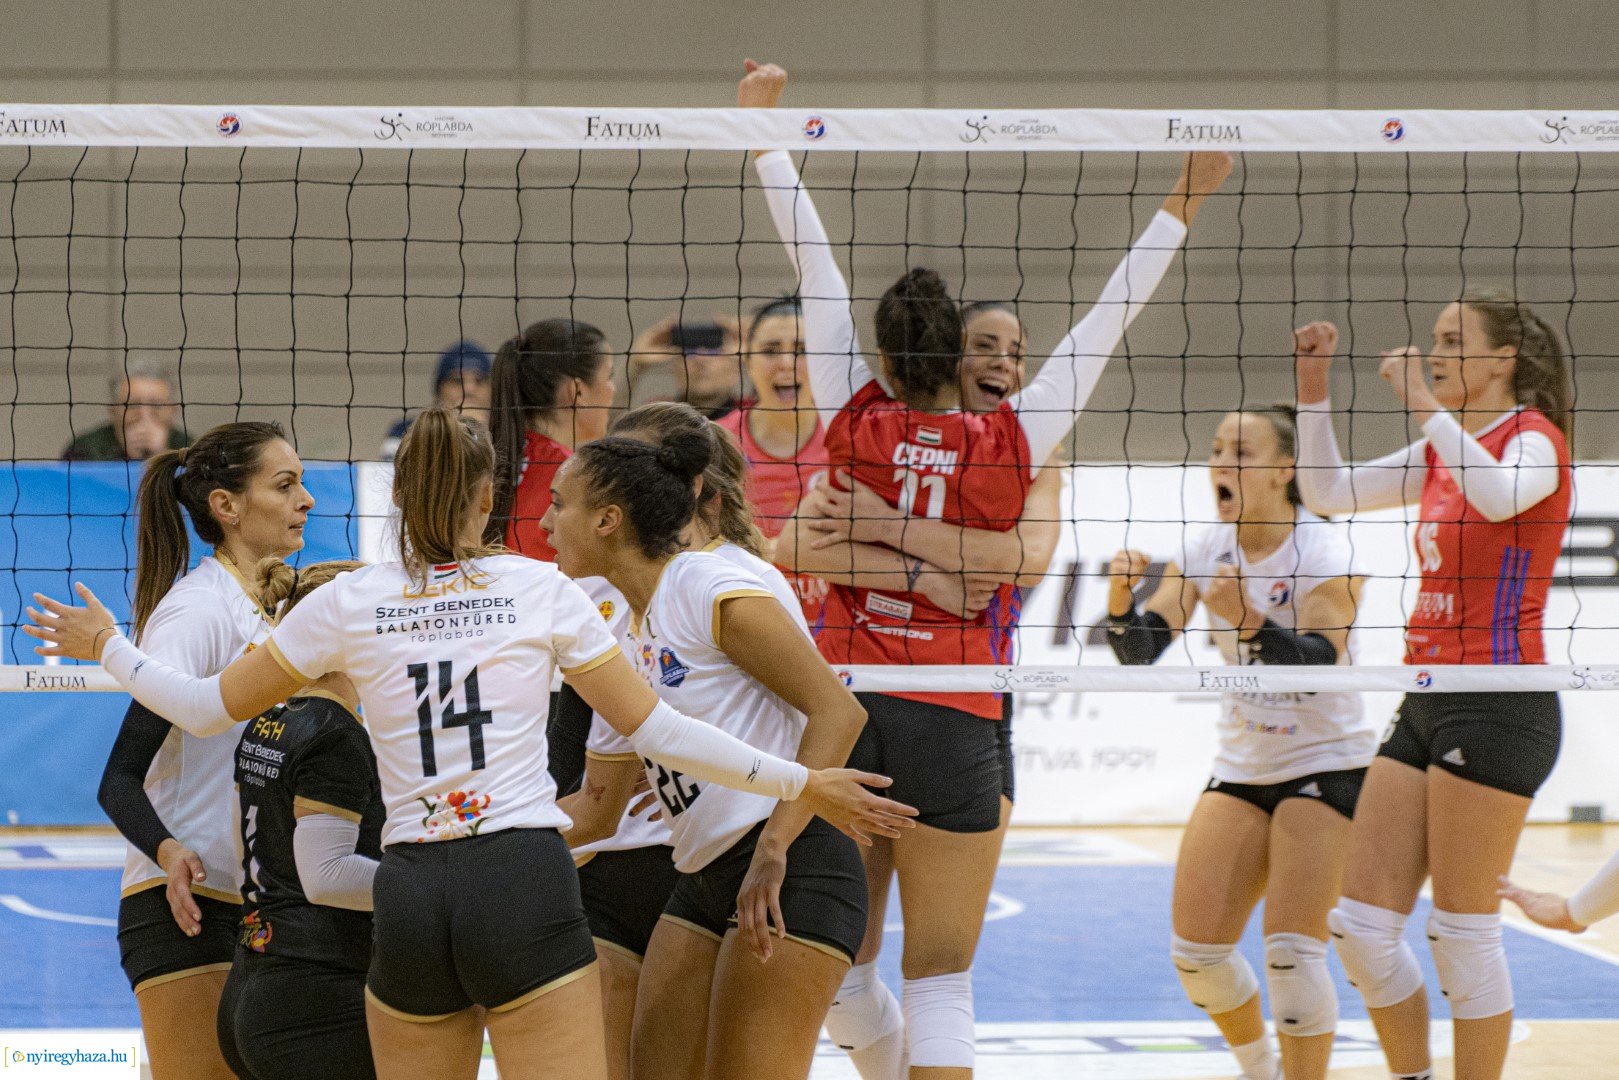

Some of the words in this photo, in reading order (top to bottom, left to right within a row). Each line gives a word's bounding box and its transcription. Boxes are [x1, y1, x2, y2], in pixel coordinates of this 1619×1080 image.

[416, 121, 474, 132] RÖPLABDA
[585, 115, 661, 137] FATUM
[1001, 123, 1058, 134] RÖPLABDA
[1167, 118, 1242, 139] FATUM
[376, 606, 430, 619] SZENT
[434, 598, 516, 613] BENEDEK
[376, 612, 517, 636] BALATONFÜRED
[411, 628, 485, 643] röplabda
[25, 670, 87, 688] FATUM
[1199, 670, 1260, 688] FATUM
[407, 660, 493, 777] 14
